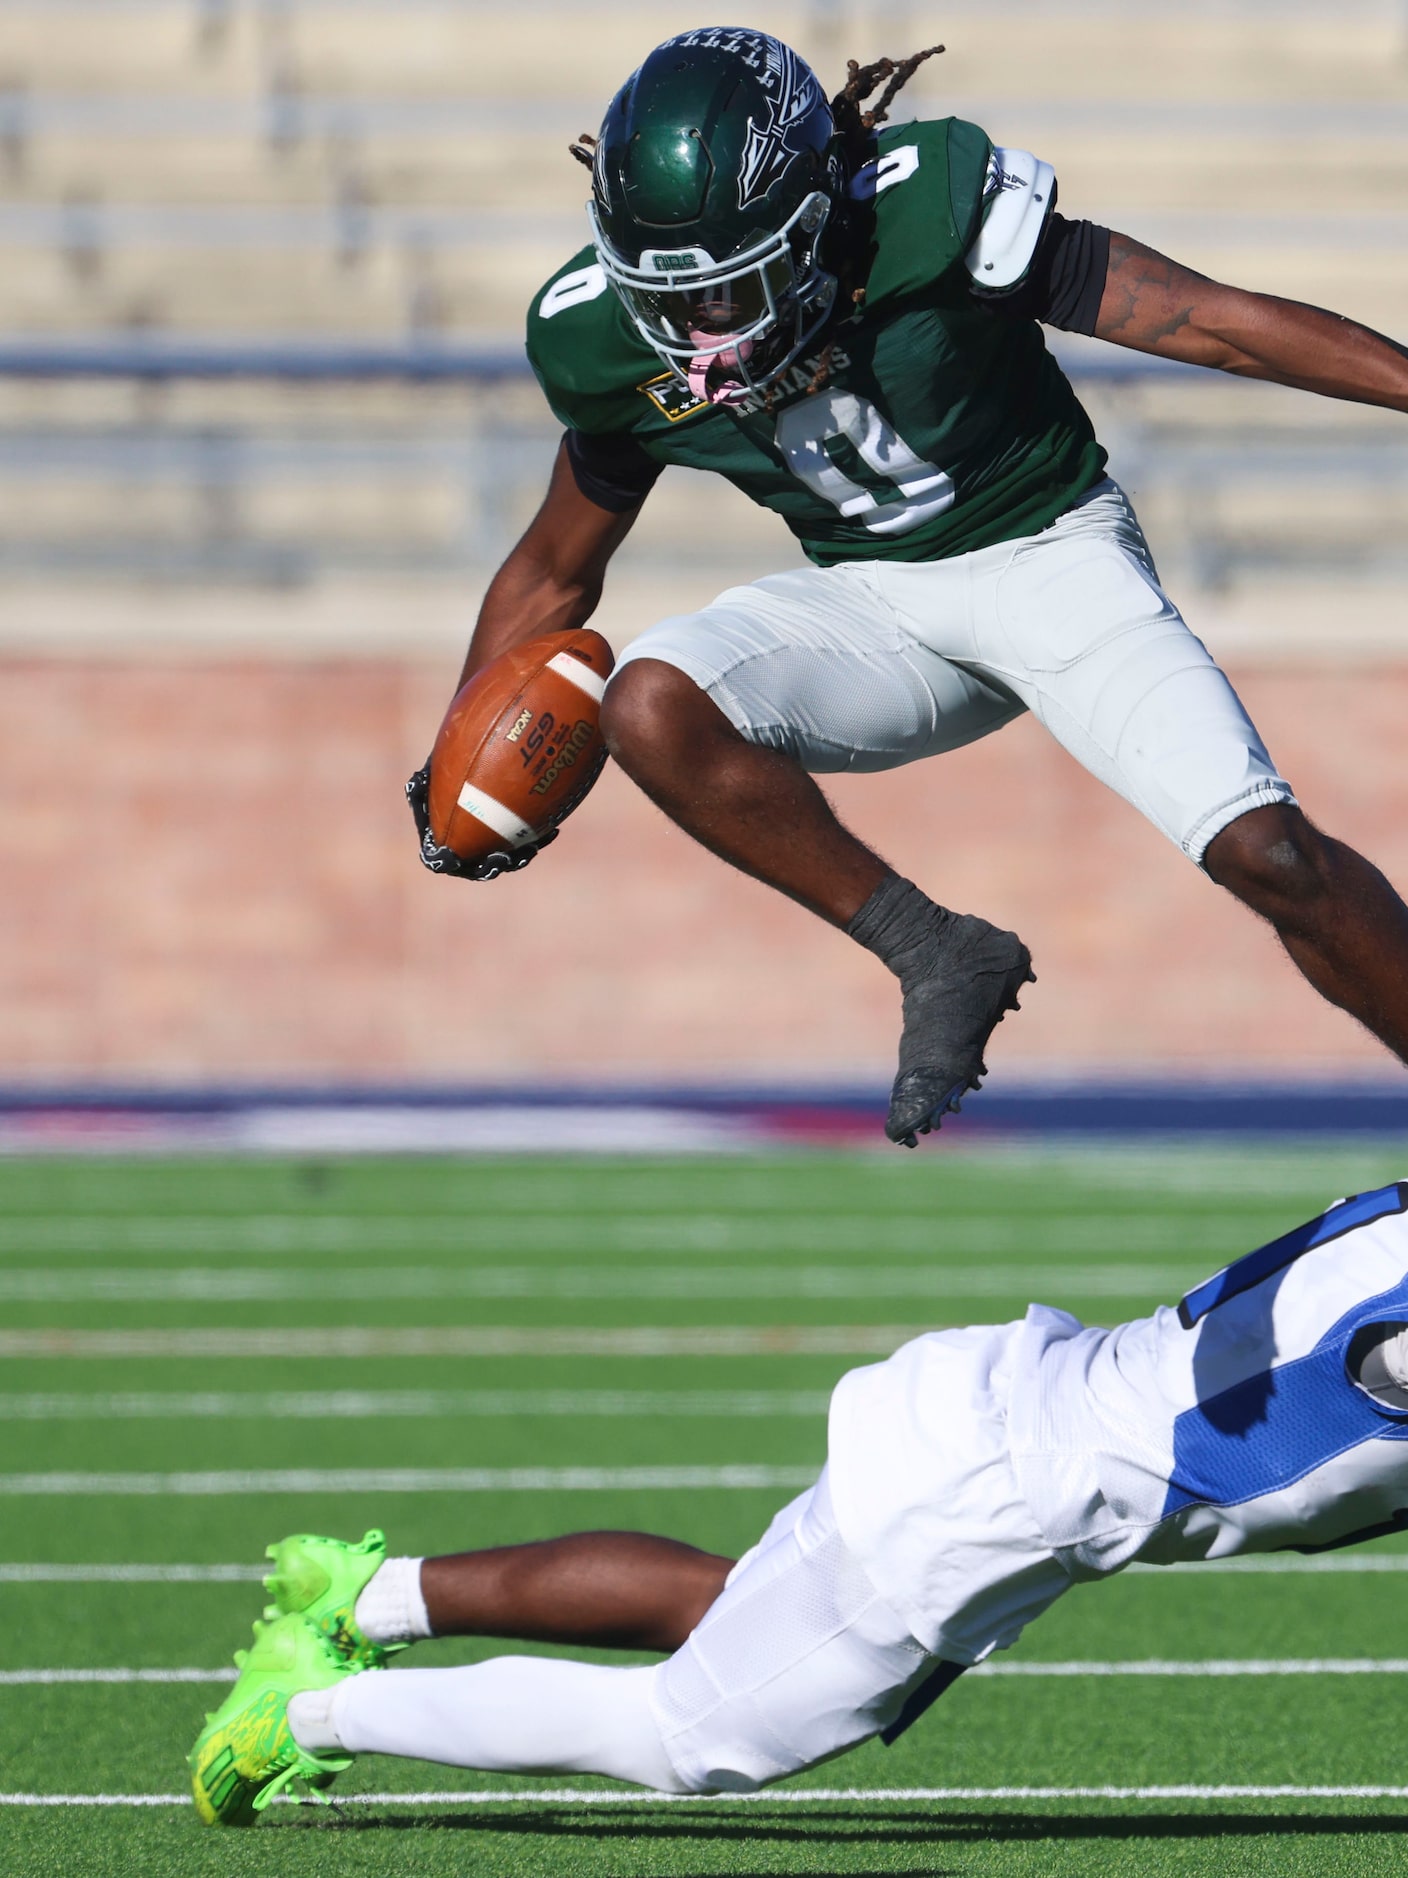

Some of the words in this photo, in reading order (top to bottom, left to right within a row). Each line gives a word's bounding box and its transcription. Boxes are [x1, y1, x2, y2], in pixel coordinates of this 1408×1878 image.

[539, 263, 607, 319] 0
[773, 387, 955, 535] 0
[505, 708, 533, 743] NCAA
[519, 711, 555, 768] GST
[531, 719, 594, 795] Wilson
